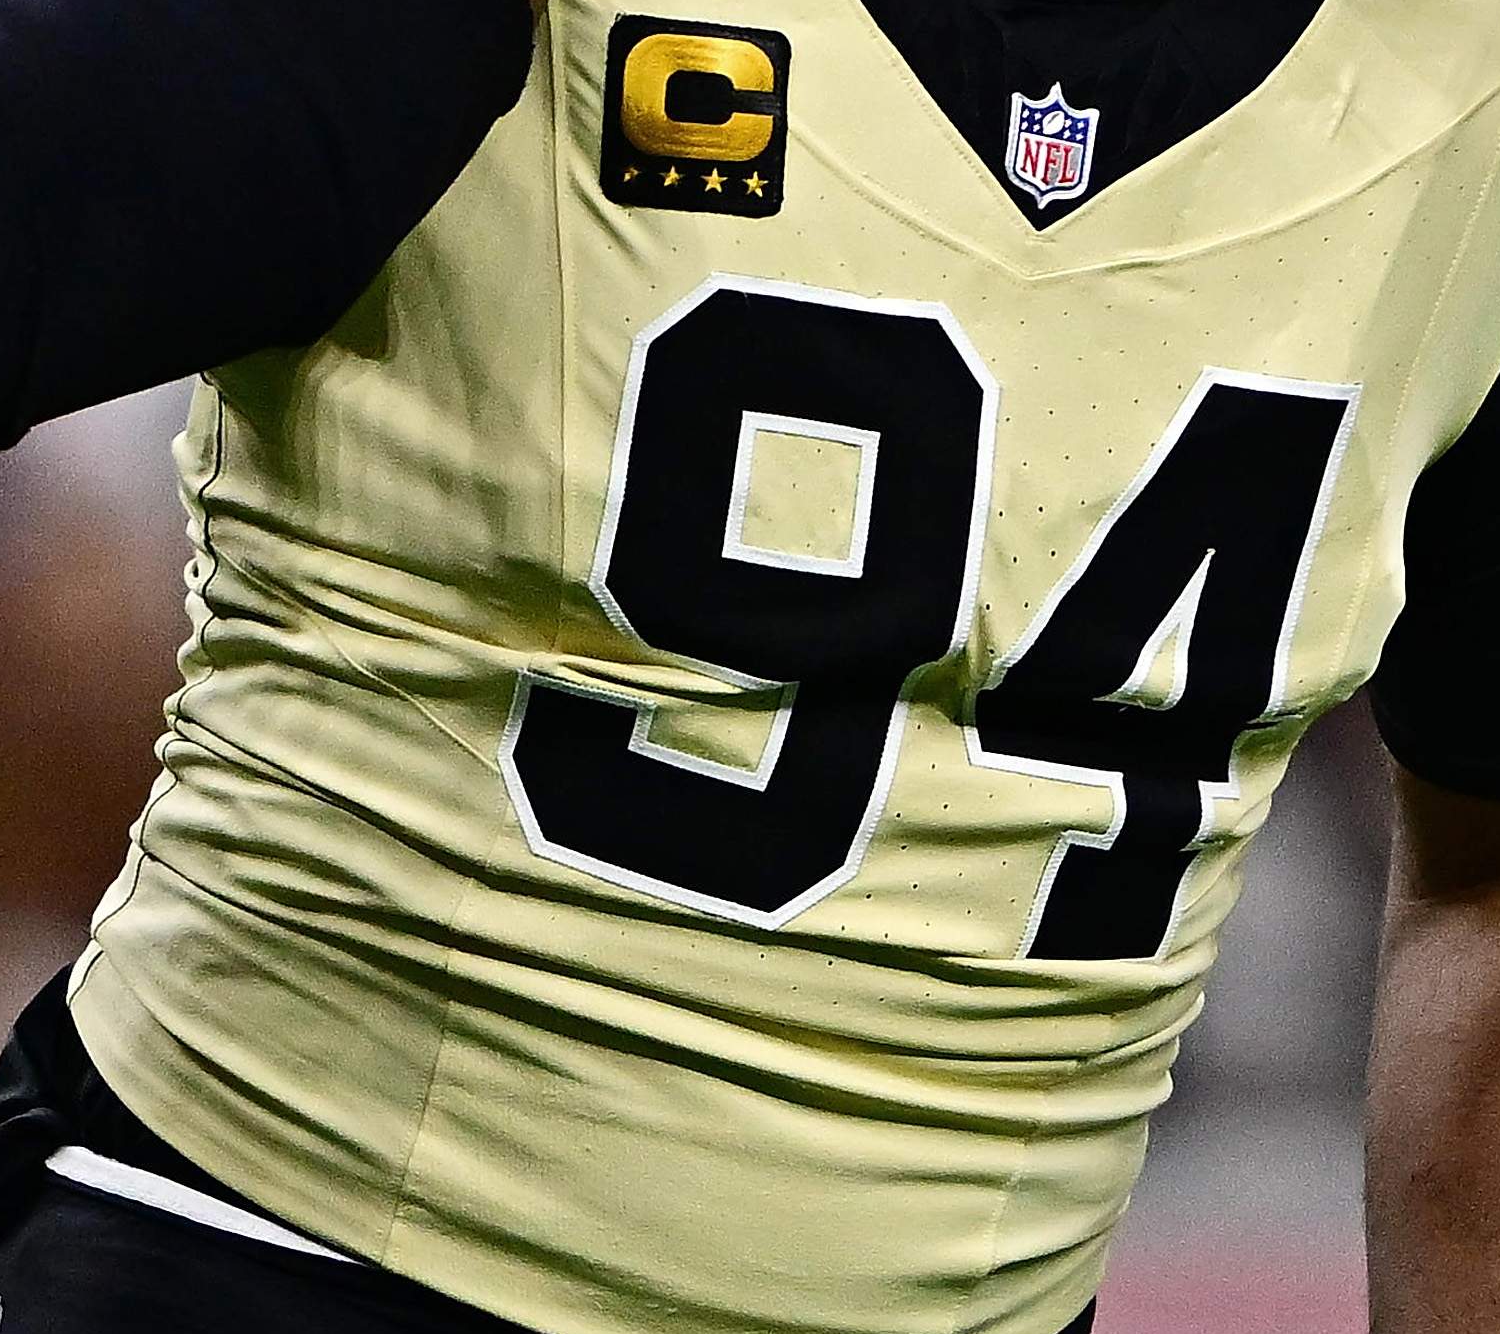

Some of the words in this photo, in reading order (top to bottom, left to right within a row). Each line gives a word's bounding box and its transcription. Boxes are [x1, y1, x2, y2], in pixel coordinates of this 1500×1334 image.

[620, 32, 775, 162] C
[1019, 137, 1079, 186] NFL
[496, 271, 1362, 960] 94
